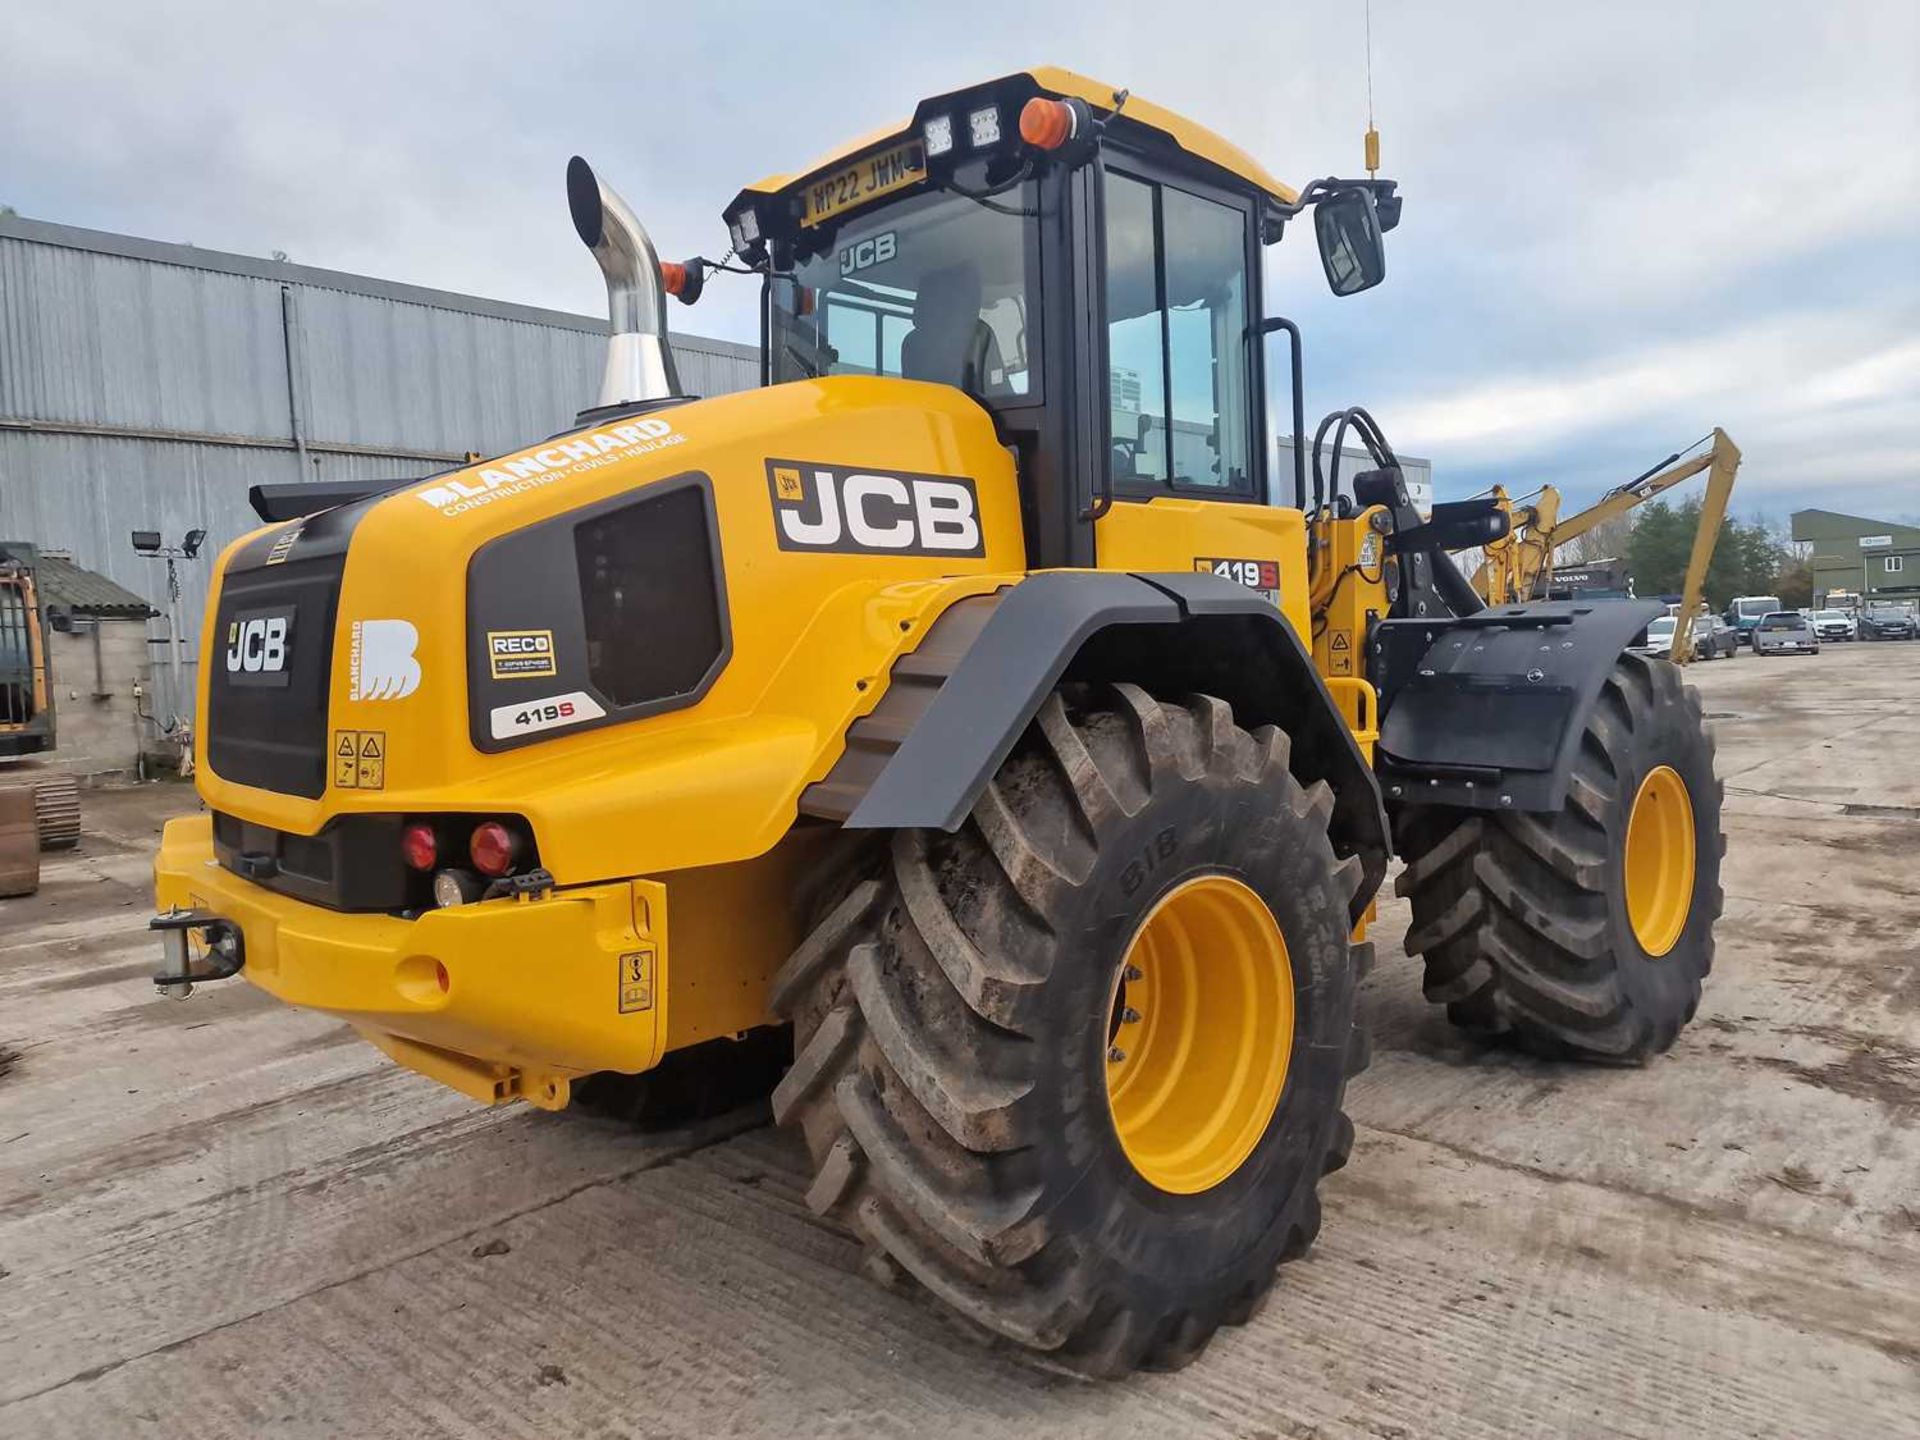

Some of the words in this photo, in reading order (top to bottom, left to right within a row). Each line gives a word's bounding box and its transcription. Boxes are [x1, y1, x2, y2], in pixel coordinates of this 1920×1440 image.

[866, 151, 906, 192] JWM
[840, 232, 896, 275] JCB
[417, 418, 673, 509] BLANCHARD
[442, 471, 565, 517] CONSTRUCTION
[572, 453, 620, 473] CIVILS
[626, 432, 689, 458] HAULAGE
[780, 470, 980, 551] JCB
[1213, 561, 1276, 587] 419S
[1554, 574, 1589, 583] VOLVO
[227, 617, 287, 672] JCB
[349, 621, 362, 702] BLANCHARD
[493, 637, 549, 653] RECO
[514, 702, 576, 726] 419S
